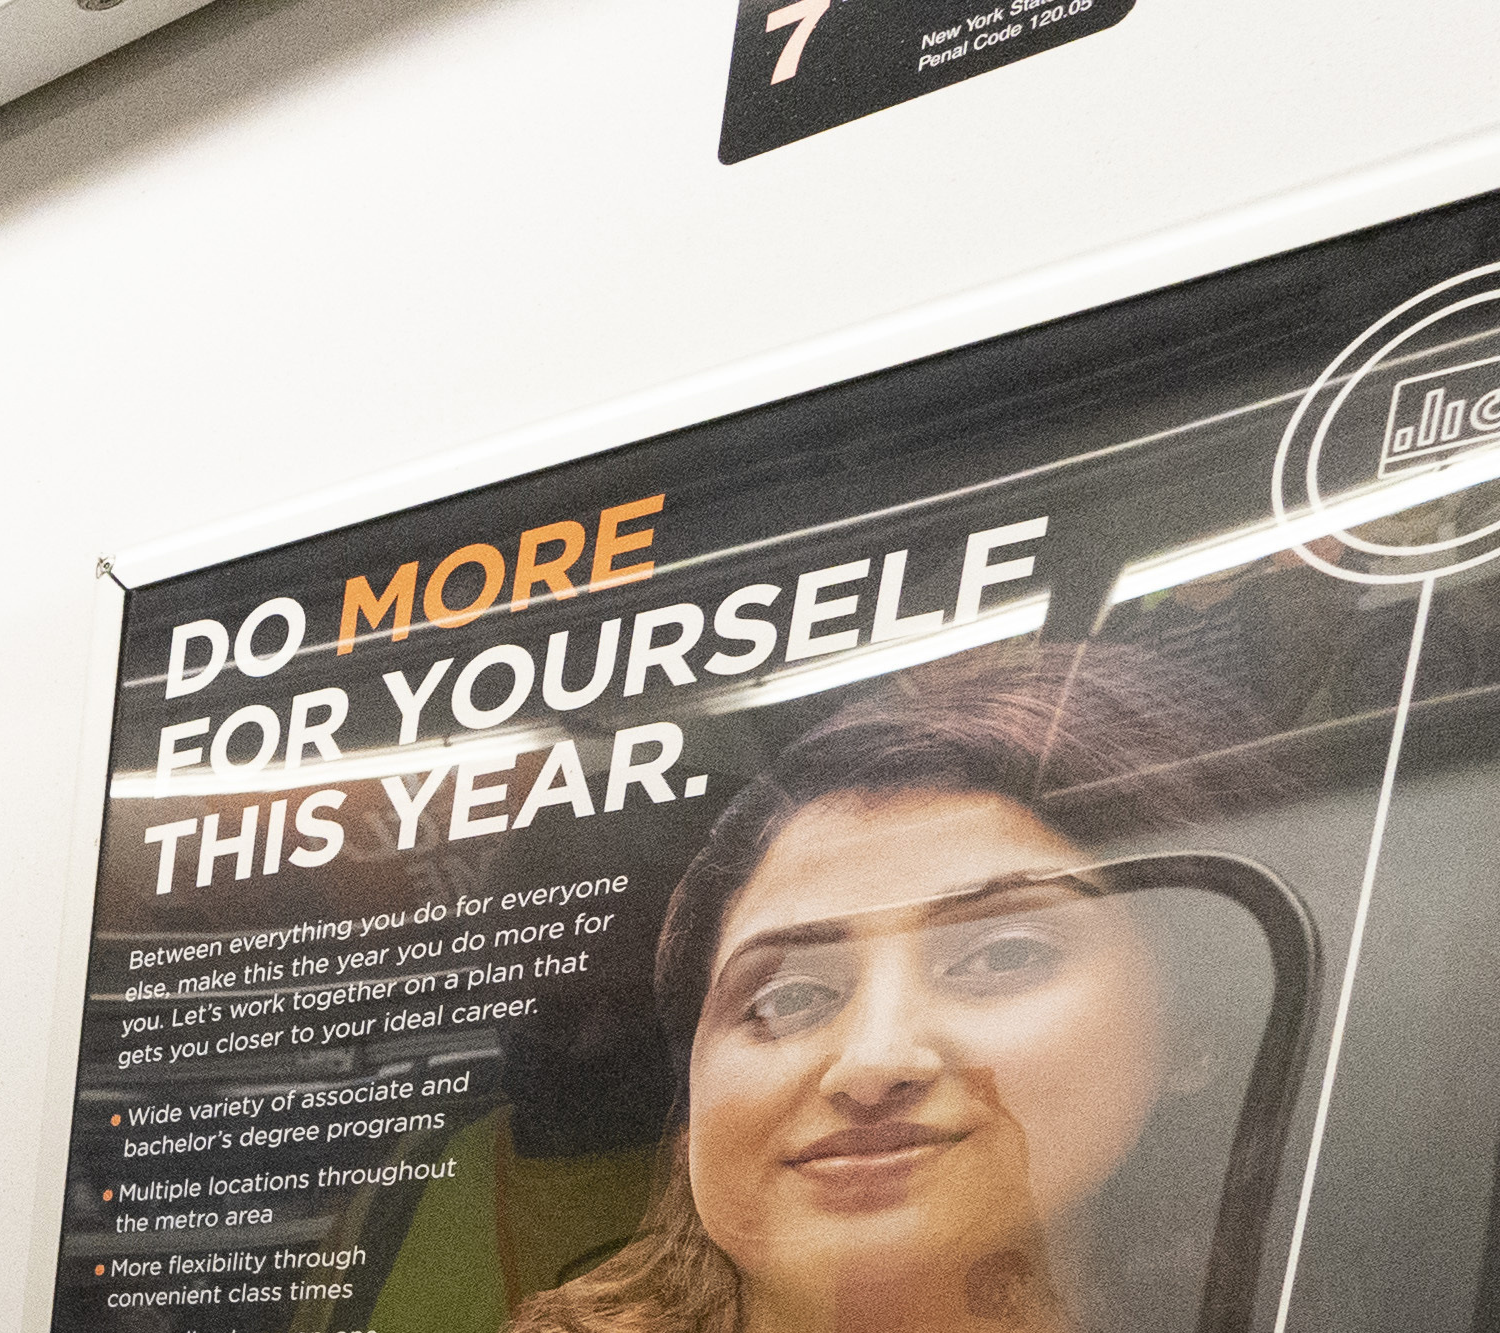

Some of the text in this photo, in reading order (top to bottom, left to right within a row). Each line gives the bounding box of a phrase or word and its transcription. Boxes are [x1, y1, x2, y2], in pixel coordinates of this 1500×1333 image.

[766, 0, 831, 85] 7
[918, 0, 1094, 72] Penal Code 120.05
[921, 0, 1058, 50] New York Sta
[163, 493, 667, 700] DO MORE
[151, 514, 1049, 801] FOR YOURSELF
[142, 721, 710, 895] THIS YEAR.
[125, 910, 615, 1004] else, make this the year you do more for
[128, 873, 630, 972] Between everything you do for everyone
[121, 951, 589, 1038] you. Let's work together on a plan that
[117, 996, 539, 1070] gets you closer to your ideal career.
[123, 1110, 446, 1160] bachelor's degree programs
[127, 1070, 472, 1129] Wide variety of associate and
[118, 1156, 457, 1206] Multiple locations throughout
[116, 1203, 274, 1235] the metro area
[106, 1277, 354, 1309] convenient class times
[110, 1245, 367, 1279] More flexibility through
